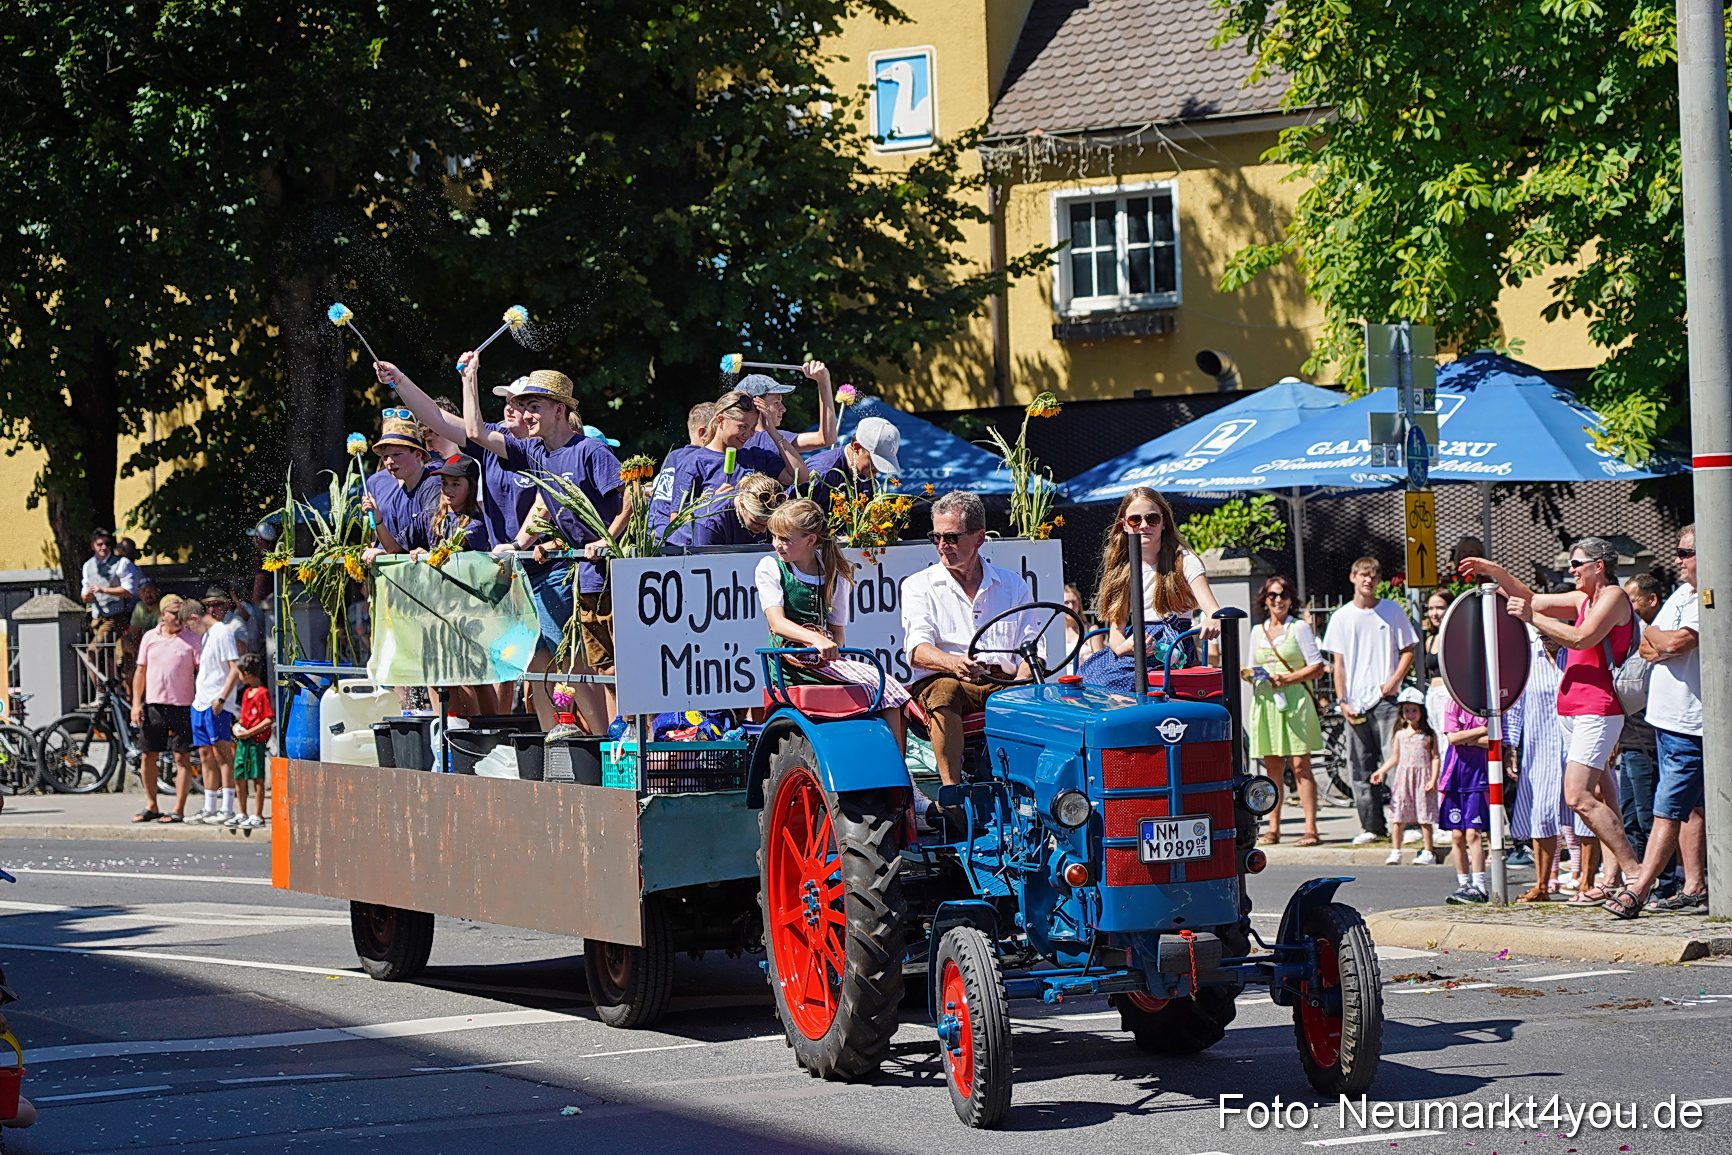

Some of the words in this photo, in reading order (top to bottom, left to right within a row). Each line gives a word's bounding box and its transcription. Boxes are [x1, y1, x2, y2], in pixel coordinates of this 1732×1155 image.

[638, 570, 683, 627] 60
[688, 568, 758, 633] Jahr
[661, 642, 756, 697] Mini's
[1156, 822, 1179, 840] NM
